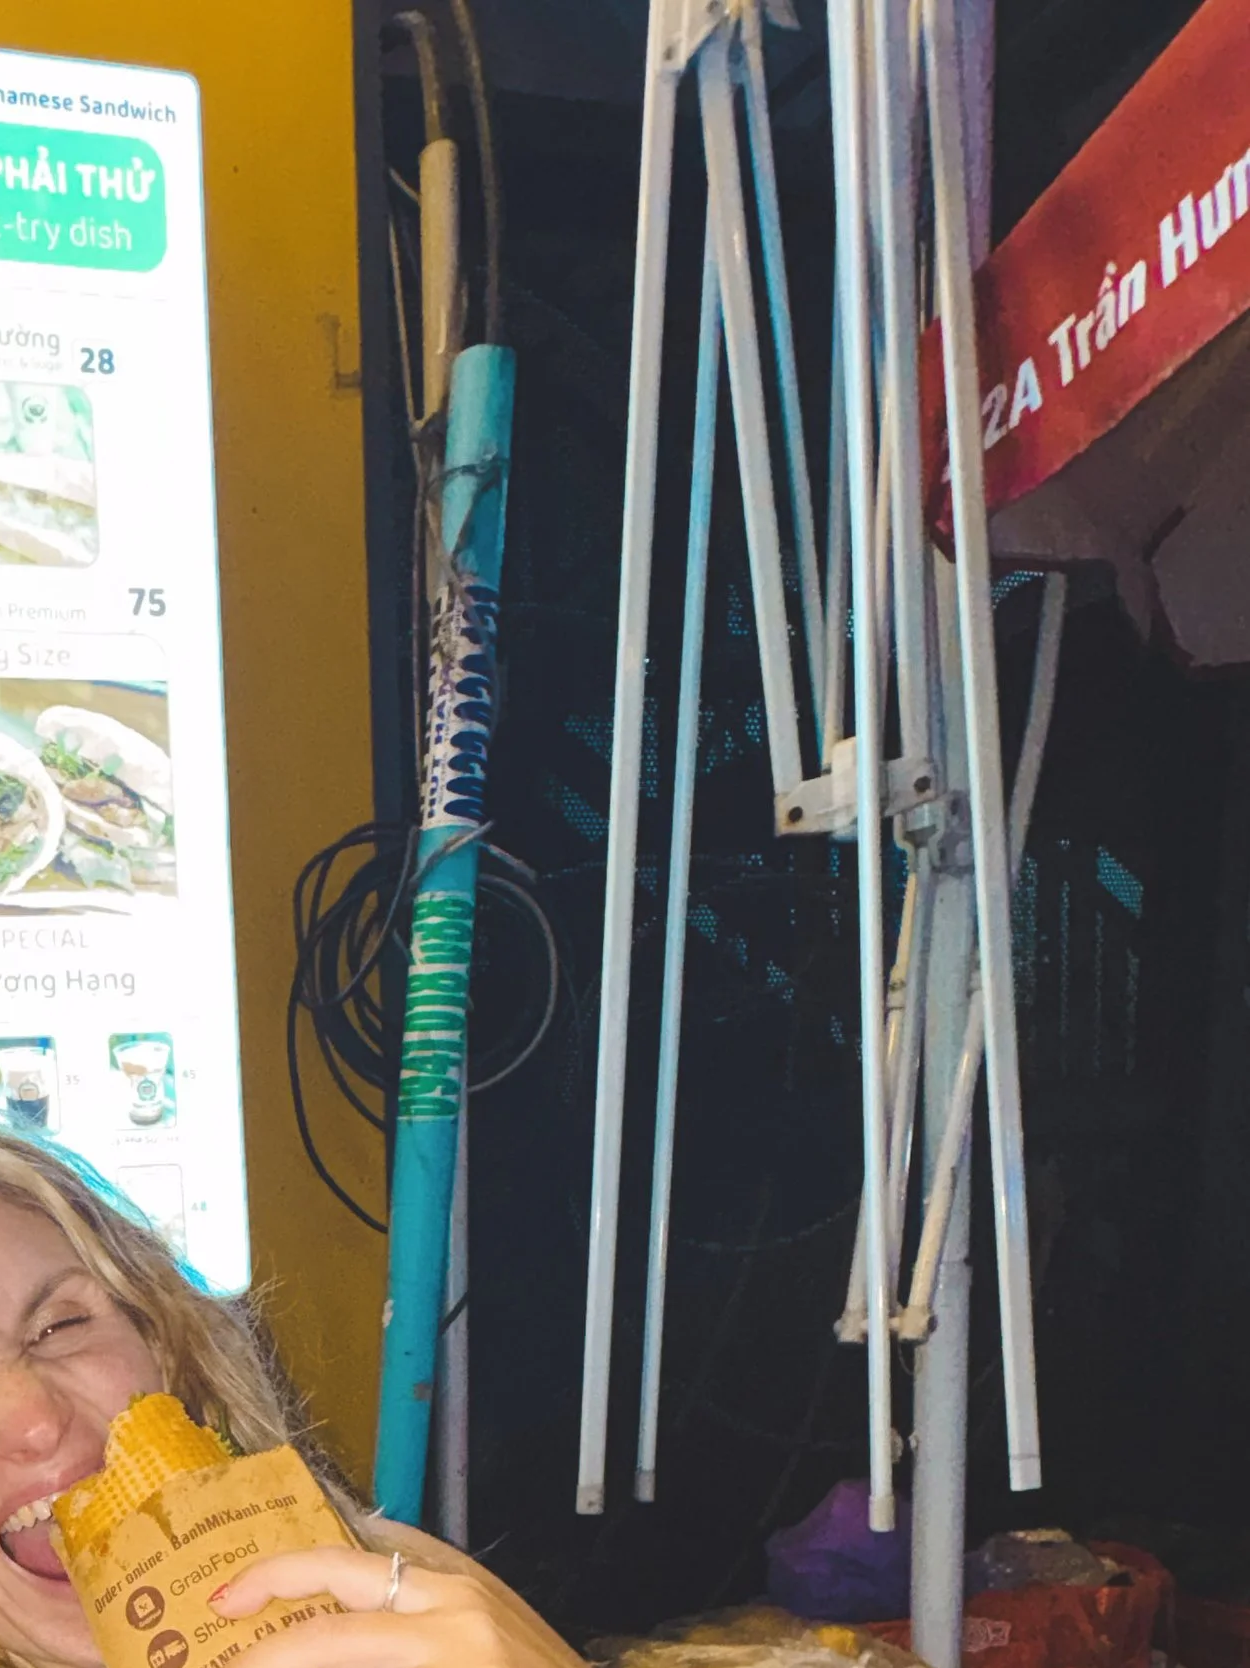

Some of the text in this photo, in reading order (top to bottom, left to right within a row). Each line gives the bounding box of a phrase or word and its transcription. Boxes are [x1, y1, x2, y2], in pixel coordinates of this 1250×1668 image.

[79, 92, 178, 124] Sandwich
[76, 163, 156, 203] THỬ
[69, 214, 132, 251] dish
[80, 346, 116, 375] 28
[8, 602, 86, 622] Premium
[128, 587, 167, 617] 75
[17, 643, 71, 667] Size
[65, 970, 136, 997] Hạng
[94, 1581, 122, 1614] Order
[168, 1495, 297, 1550] BanhMiXanh.com
[170, 1539, 259, 1596] GrabFood
